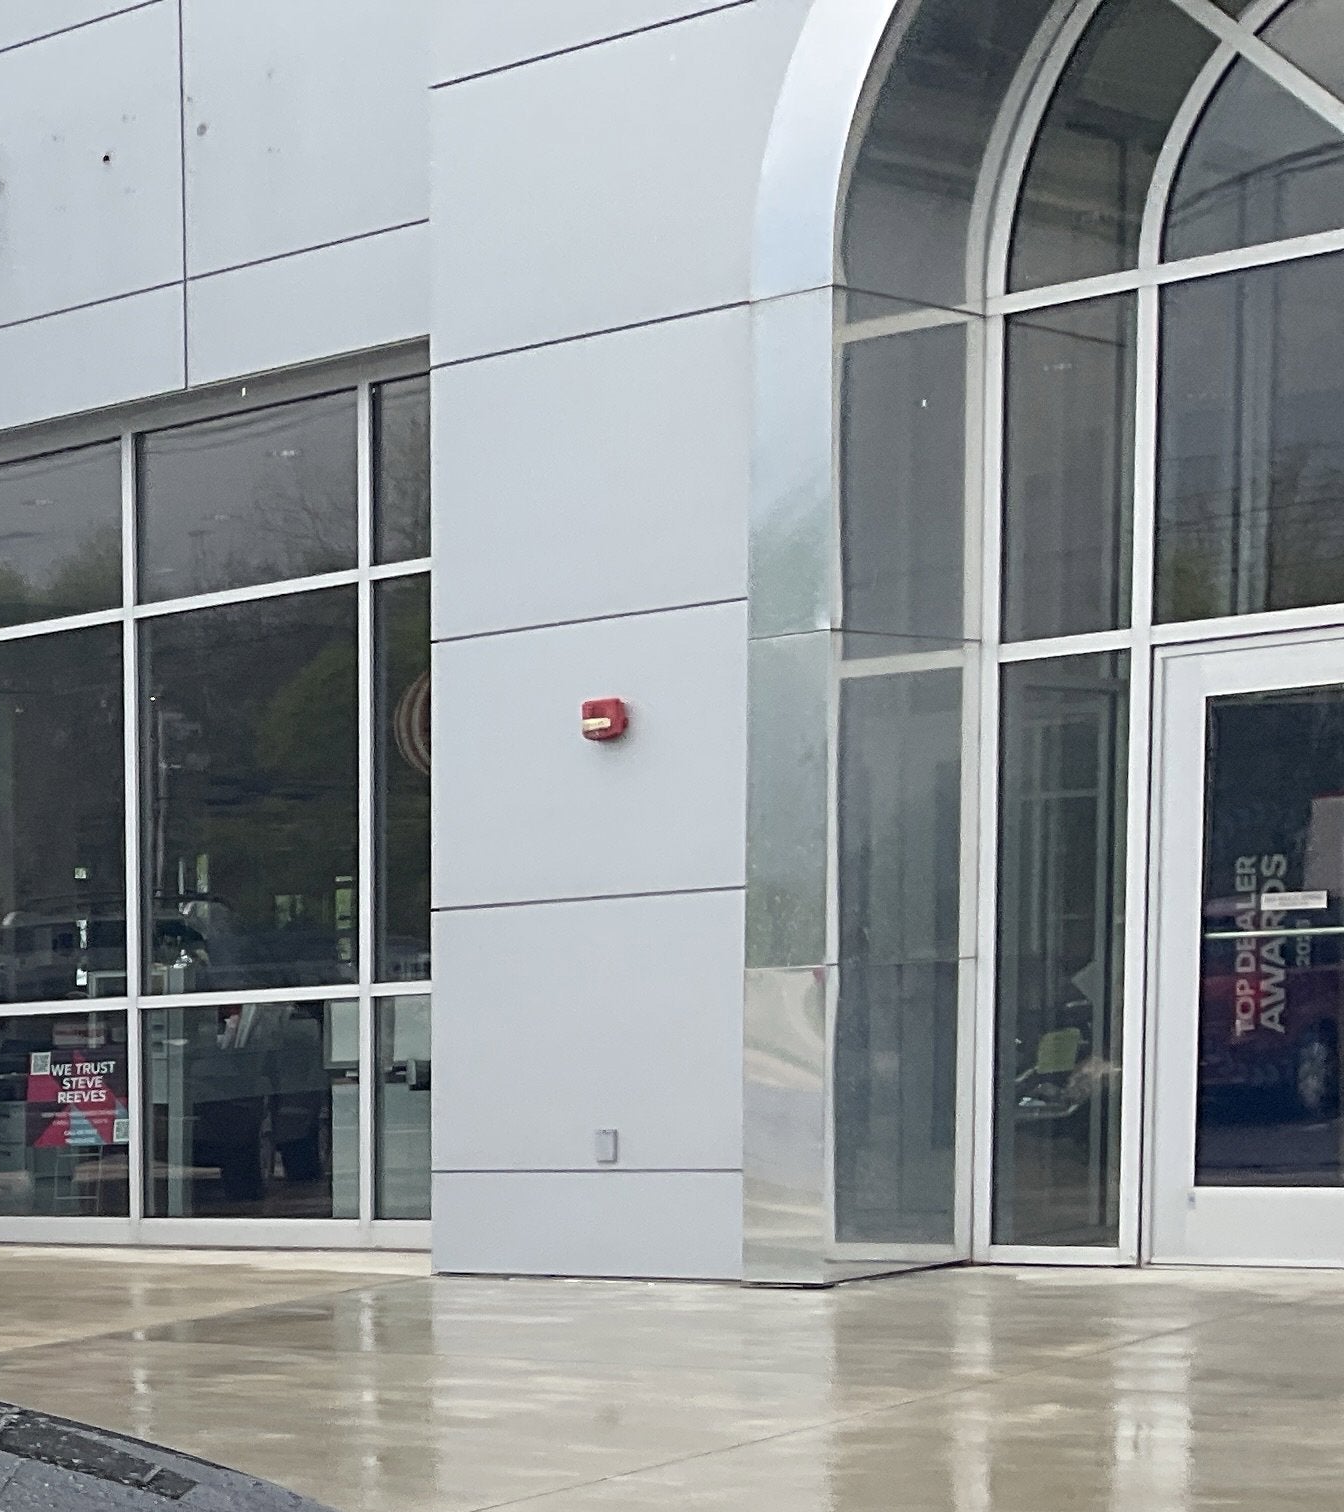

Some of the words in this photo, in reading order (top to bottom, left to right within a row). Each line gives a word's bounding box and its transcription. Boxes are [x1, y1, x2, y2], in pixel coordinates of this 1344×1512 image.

[1235, 855, 1257, 973] DEALER
[1235, 979, 1256, 1036] TOP
[51, 1063, 72, 1077] WE
[76, 1061, 116, 1075] TRUST
[62, 1076, 103, 1090] STEVE
[57, 1090, 106, 1104] REEVES
